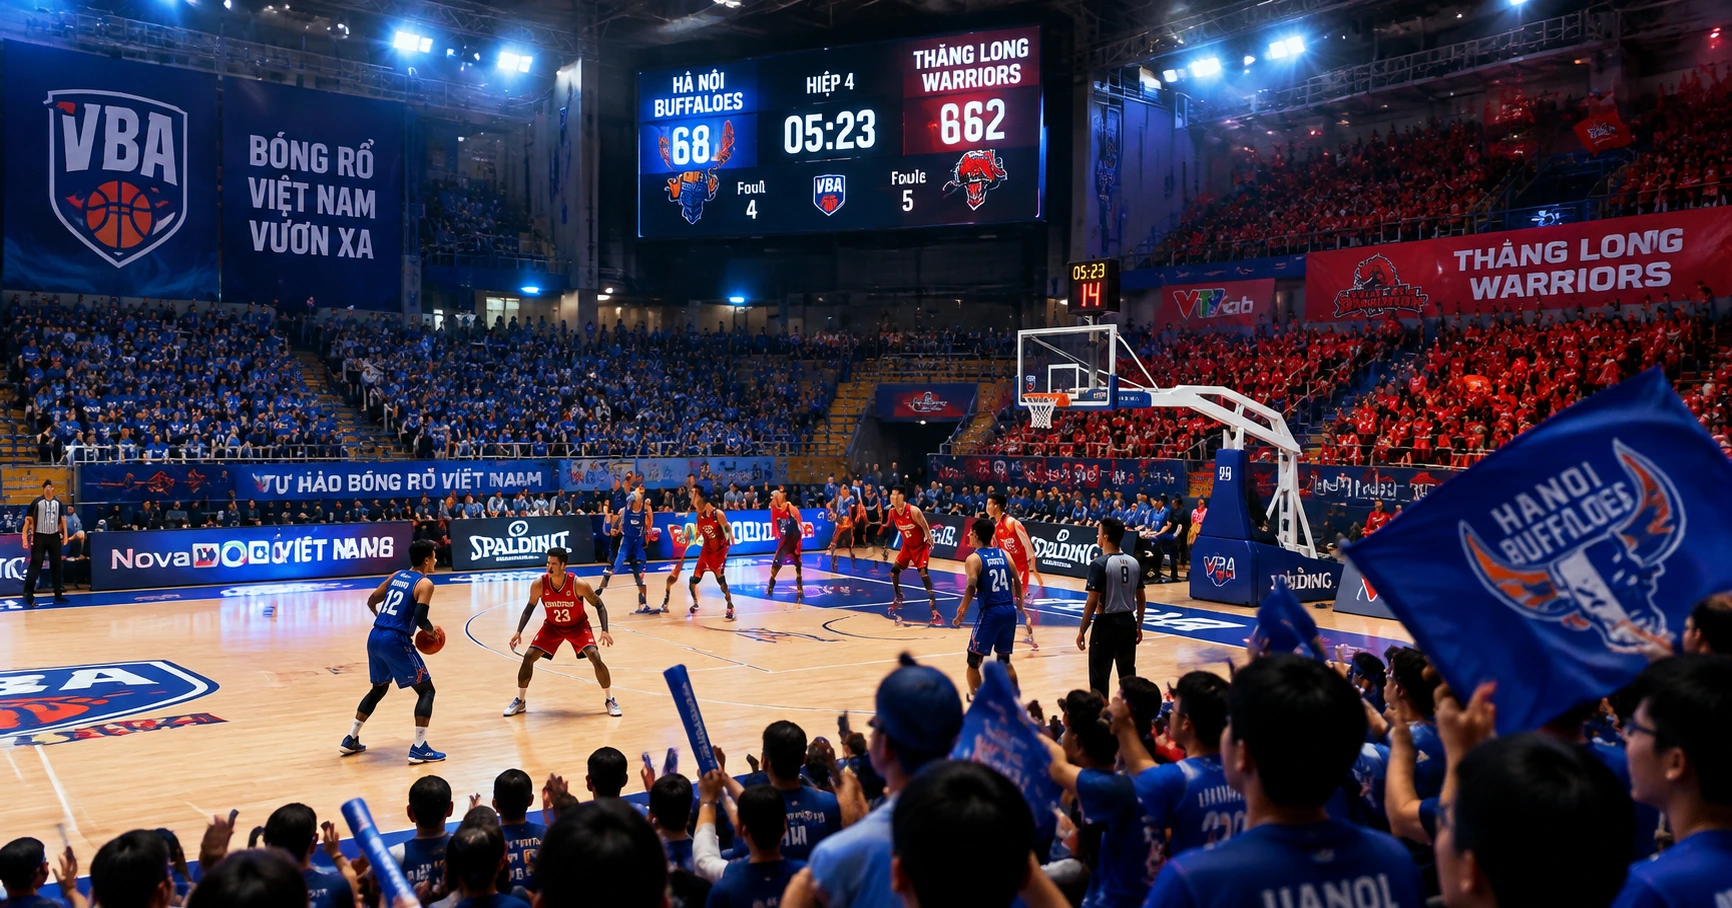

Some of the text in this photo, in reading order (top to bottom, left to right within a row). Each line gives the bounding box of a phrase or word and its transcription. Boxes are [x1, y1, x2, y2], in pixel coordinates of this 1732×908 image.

[913, 37, 1030, 70] THĂNG LONG
[698, 68, 725, 92] NỘI
[806, 71, 855, 97] HIỆP 4
[921, 63, 1022, 93] WARRIORS
[653, 92, 744, 118] BUFFALOES
[61, 102, 178, 187] VBA
[672, 124, 711, 166] 68
[784, 109, 876, 155] 05:23
[249, 131, 375, 180] BÓNG RỔ
[247, 175, 376, 219] VIỆT NAM
[815, 177, 843, 194] VBA
[746, 199, 758, 220] 4
[902, 189, 914, 212] 5
[249, 219, 375, 259] VƯƠN XA
[1579, 228, 1684, 263] LONG
[1073, 262, 1106, 281] 05:23
[1469, 261, 1672, 301] WARRIORS
[1080, 281, 1101, 308] 14
[1490, 461, 1604, 536] HANOI
[111, 547, 190, 570] Nova
[989, 568, 1009, 593] 24
[381, 588, 404, 616] 12
[553, 608, 571, 622] 23
